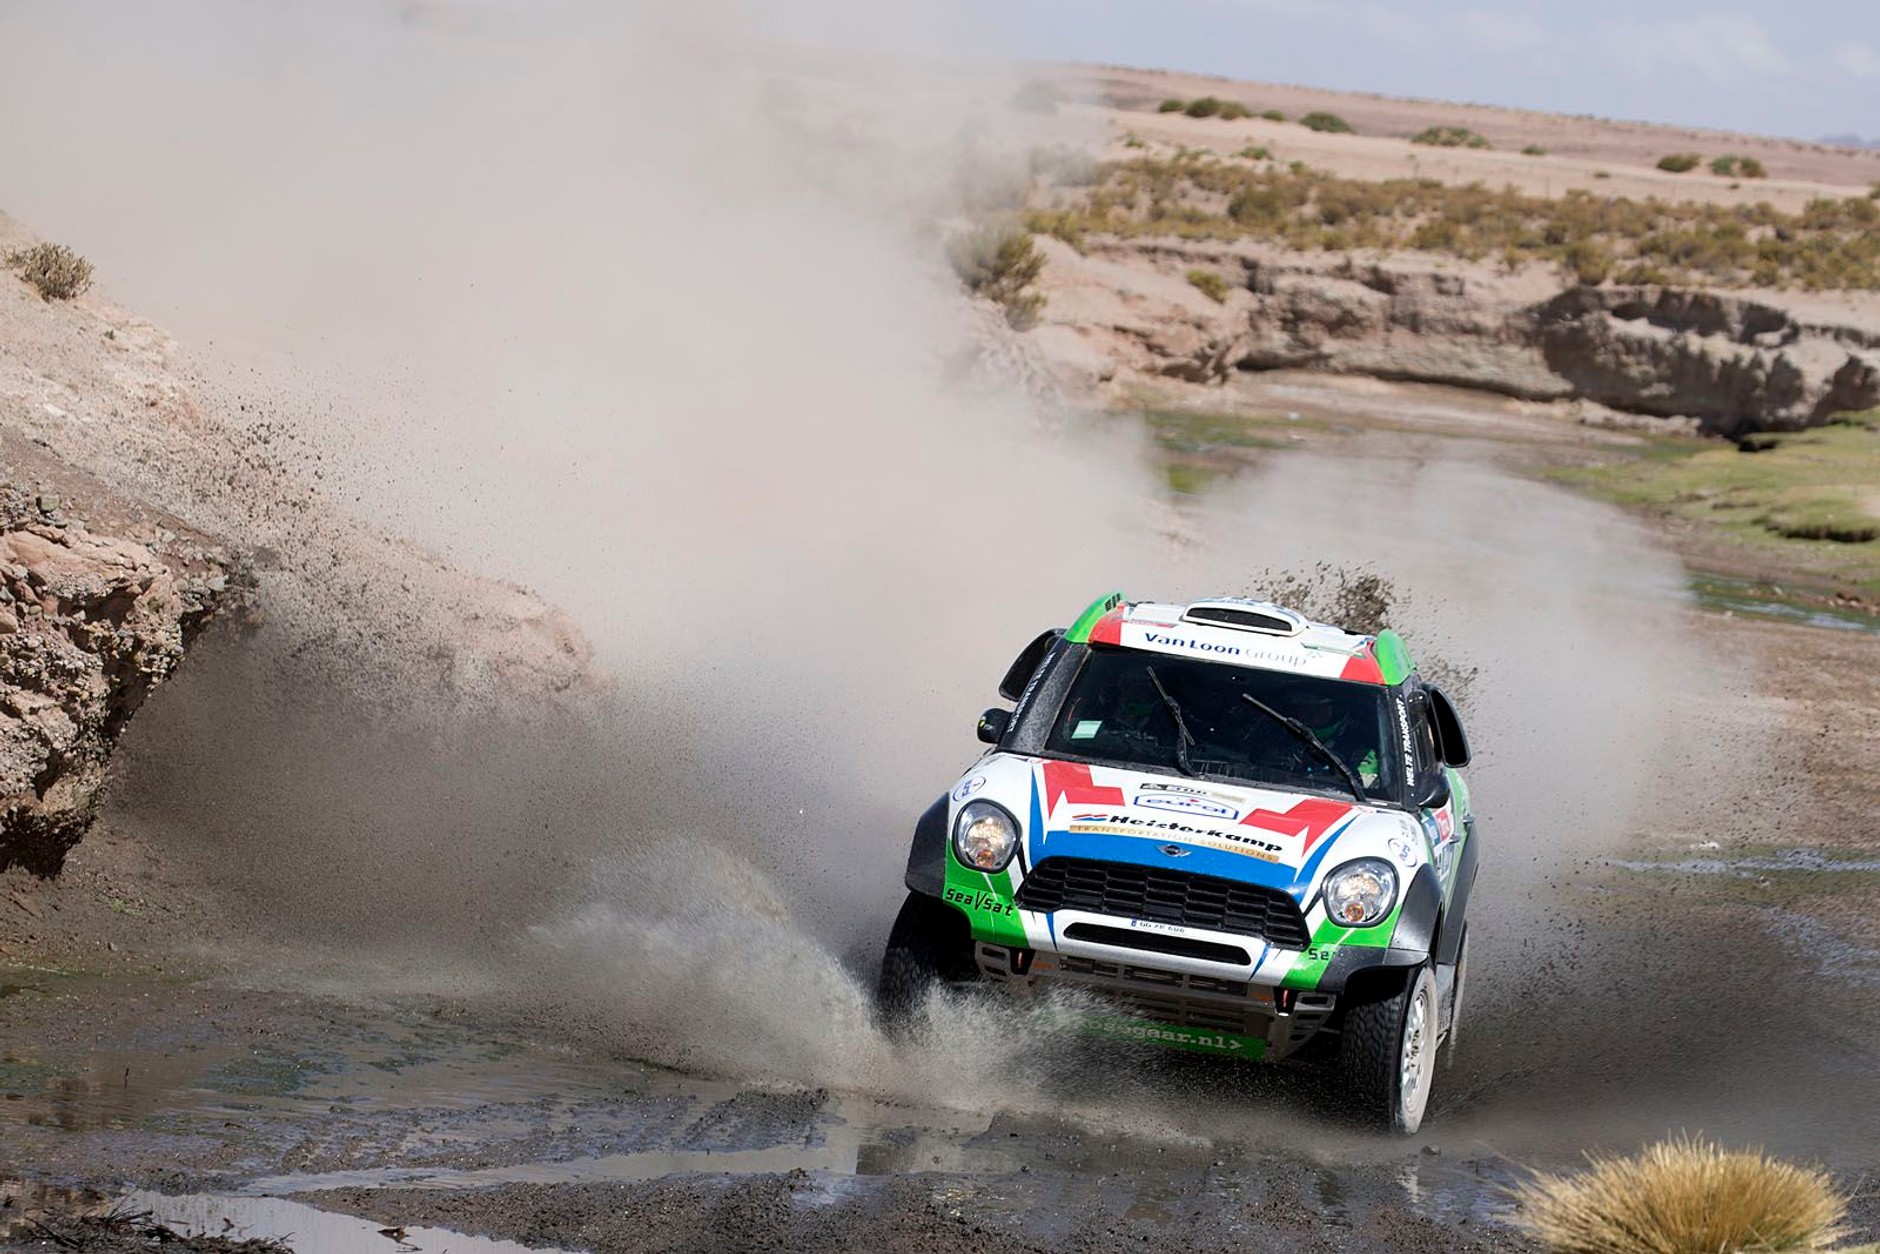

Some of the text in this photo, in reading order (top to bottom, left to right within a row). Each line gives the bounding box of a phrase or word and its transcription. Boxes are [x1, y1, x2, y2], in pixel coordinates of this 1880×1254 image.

[1144, 632, 1308, 667] Van Loon Group
[1395, 697, 1413, 753] TRANSPORT
[1076, 825, 1193, 844] TRANSPORTATION
[1199, 839, 1275, 862] SOLUTIONS
[1108, 815, 1283, 852] Heisterkamp
